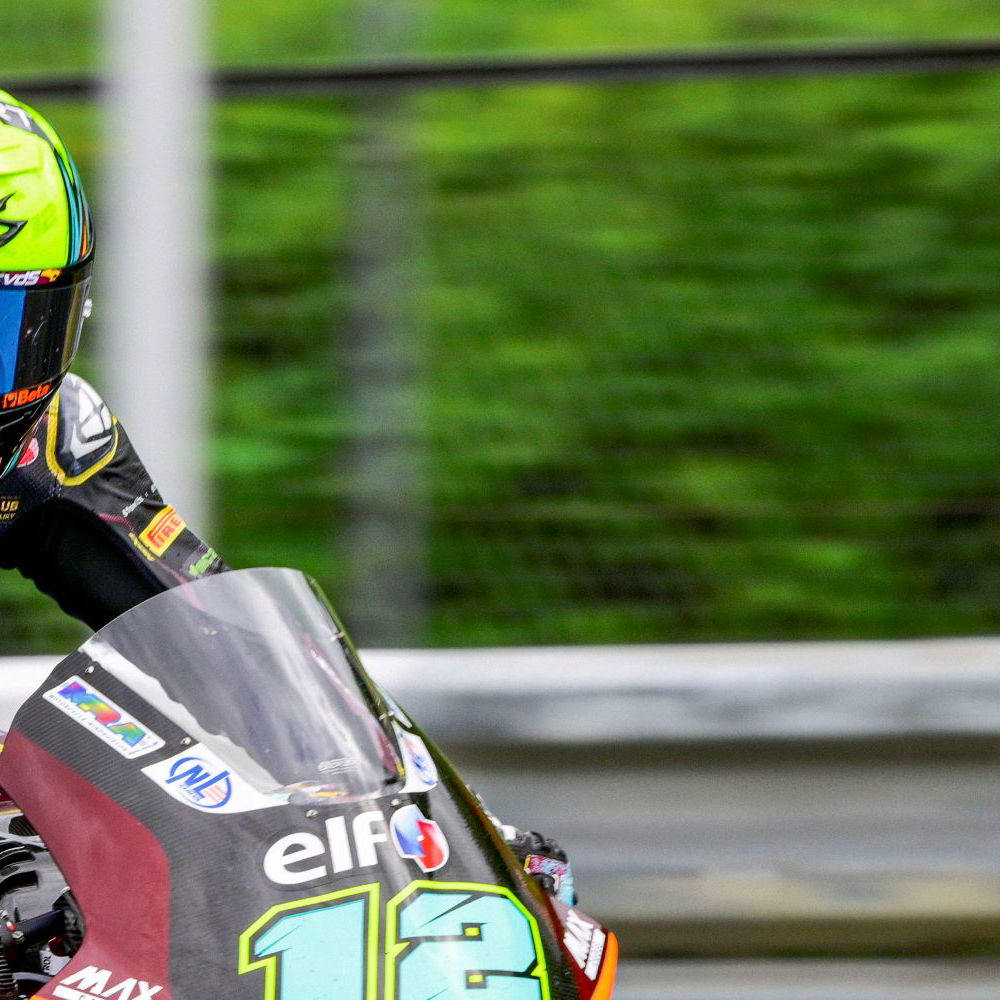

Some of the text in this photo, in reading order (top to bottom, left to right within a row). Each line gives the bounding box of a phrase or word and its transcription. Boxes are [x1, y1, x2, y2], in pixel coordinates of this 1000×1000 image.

[16, 383, 53, 405] Beta
[146, 508, 186, 549] PIRE
[57, 681, 147, 748] MRA
[263, 810, 388, 886] elf
